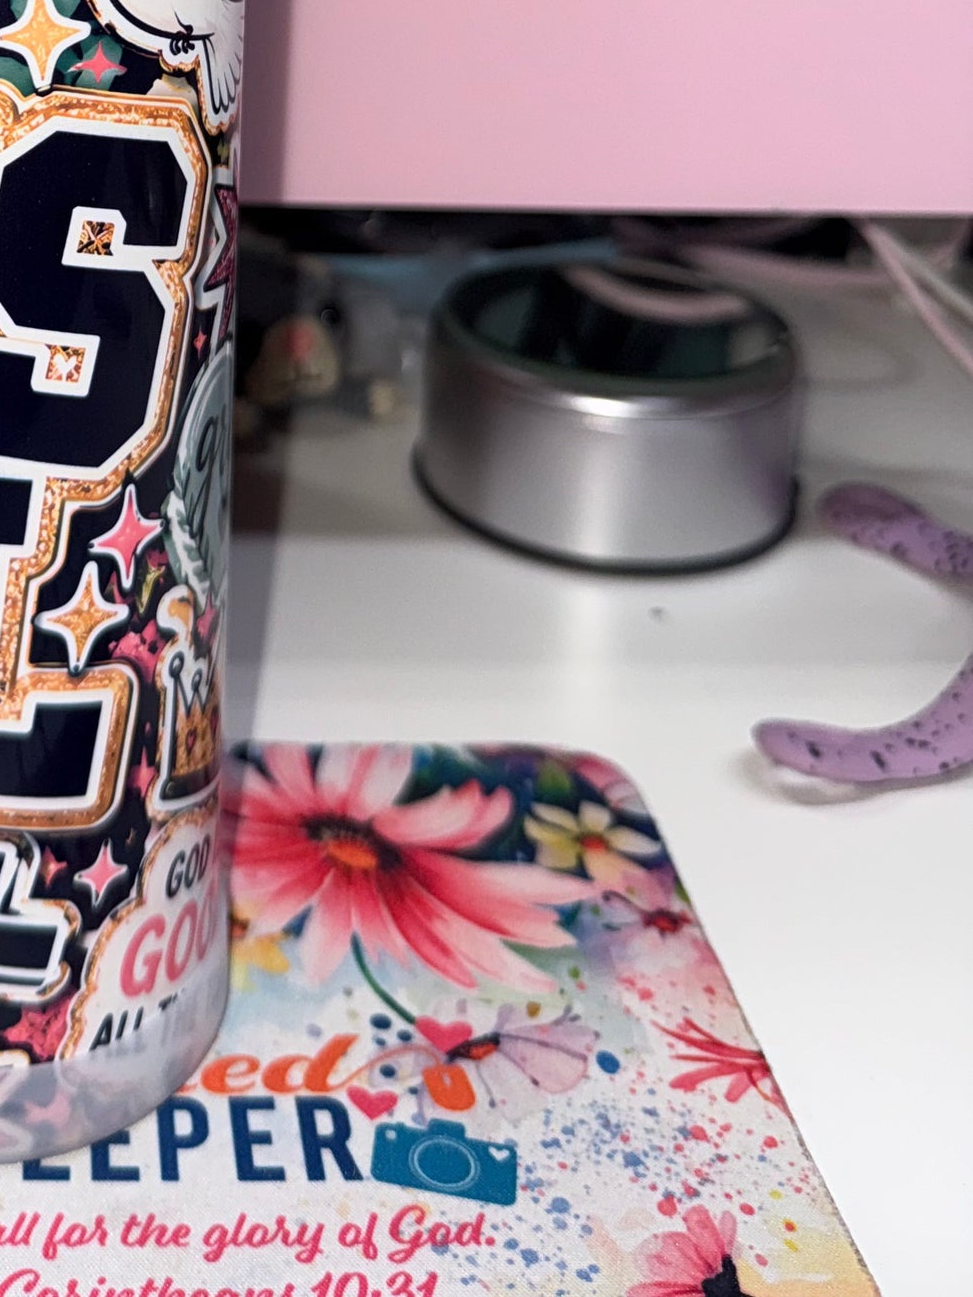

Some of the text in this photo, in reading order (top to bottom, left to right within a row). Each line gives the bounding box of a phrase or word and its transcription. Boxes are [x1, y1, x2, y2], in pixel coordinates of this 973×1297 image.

[42, 1213, 109, 1261] for
[119, 1213, 191, 1248] the
[202, 1212, 327, 1264] glory
[338, 1211, 381, 1264] of
[387, 1204, 496, 1264] God.
